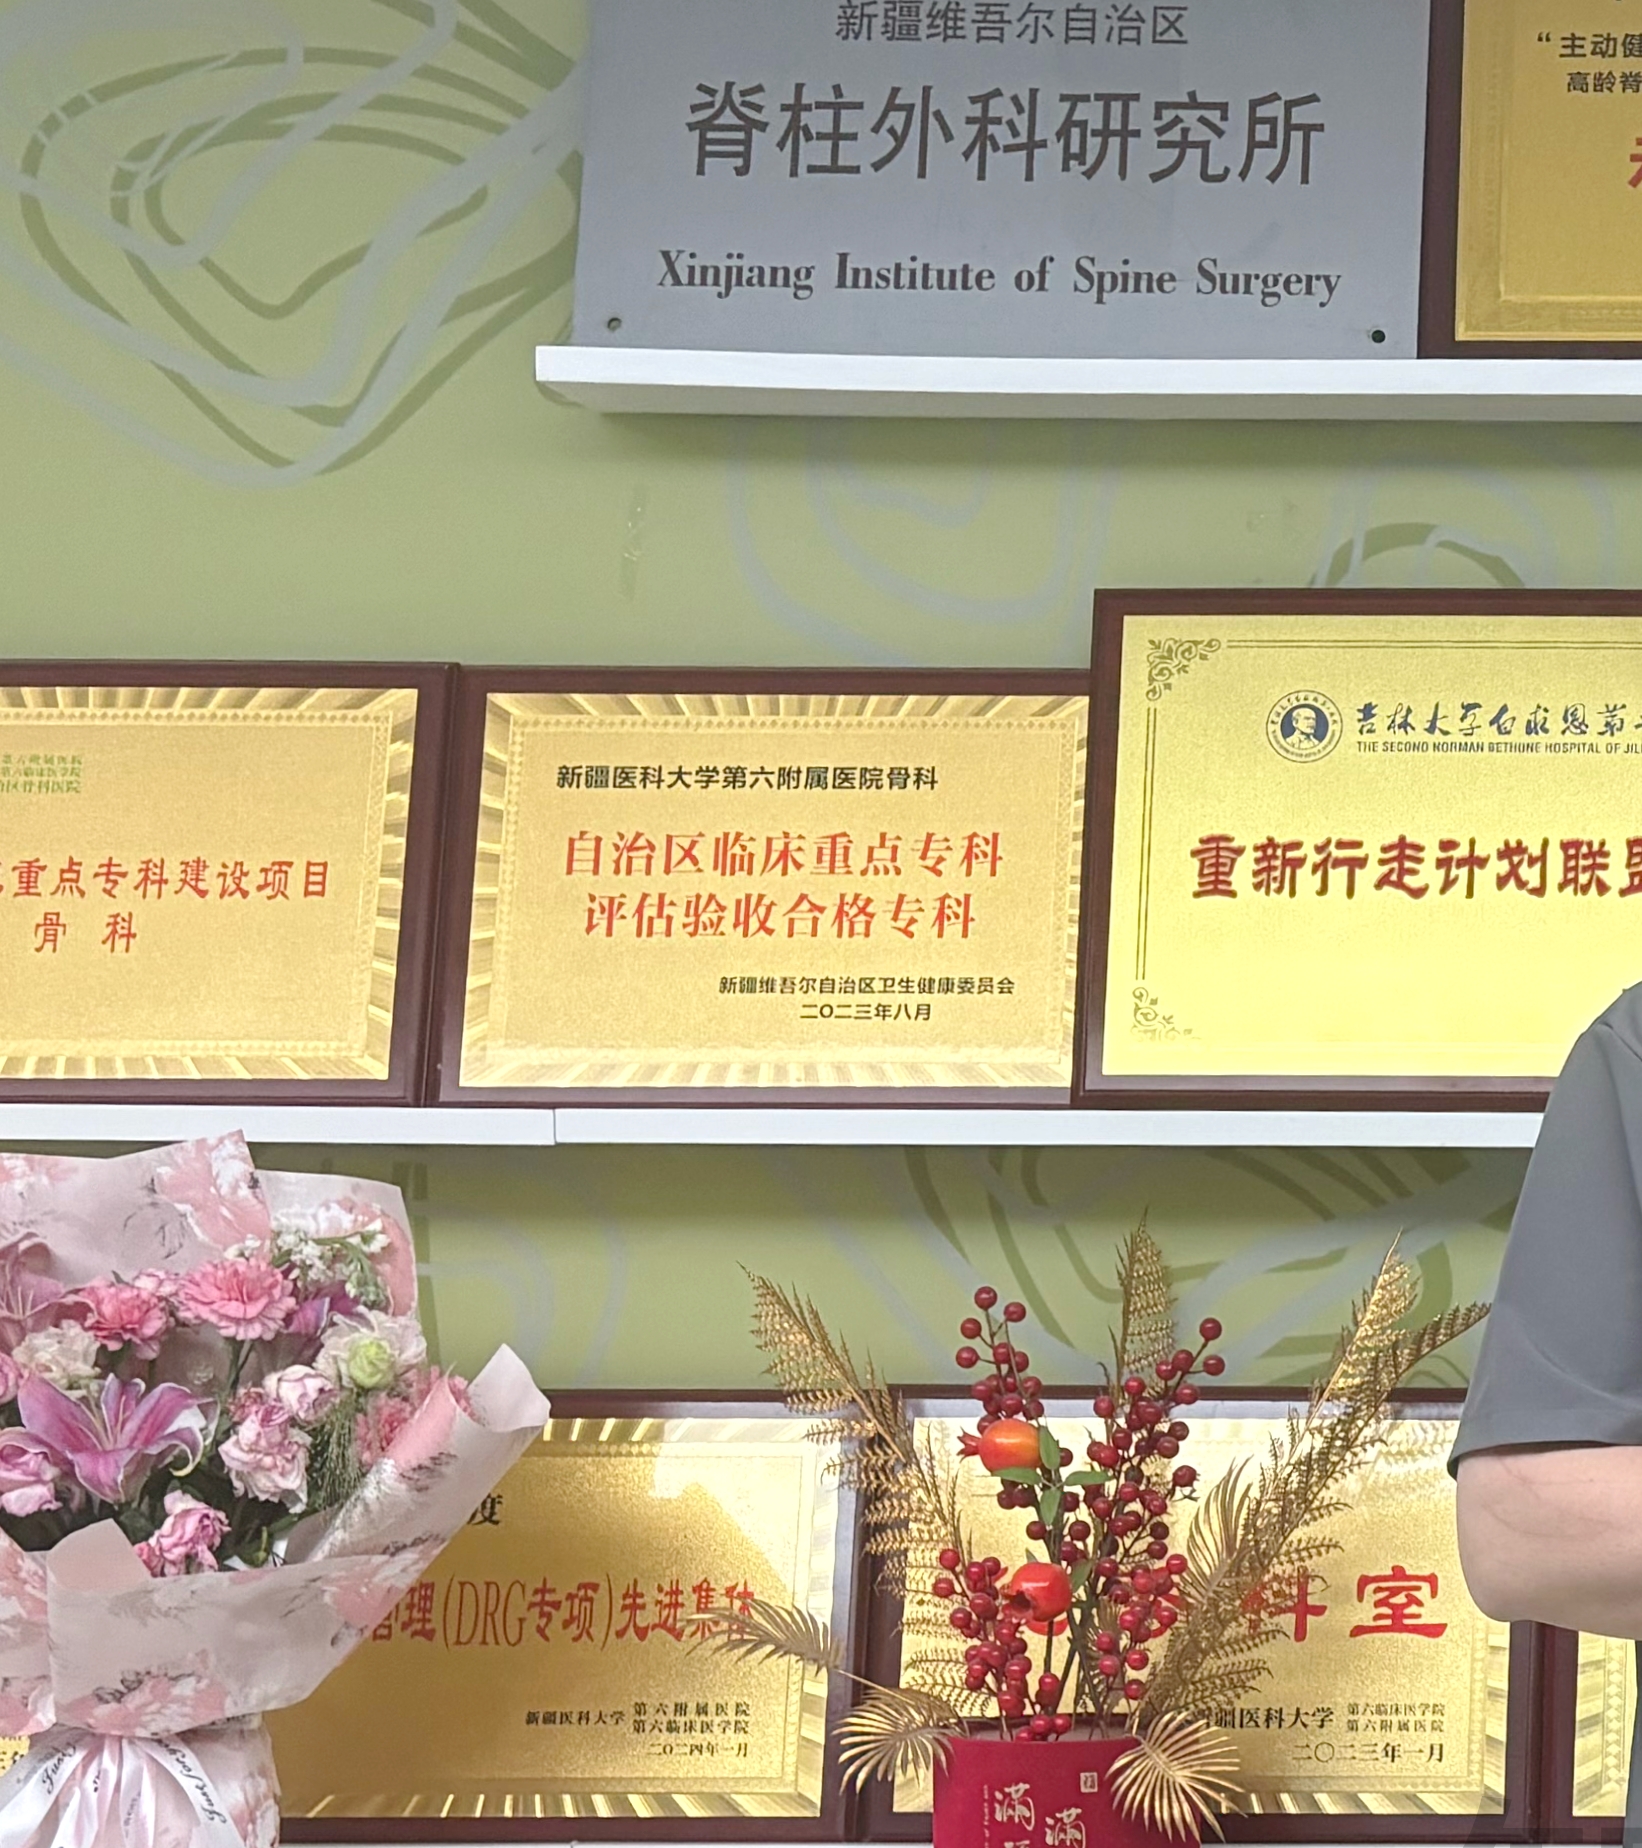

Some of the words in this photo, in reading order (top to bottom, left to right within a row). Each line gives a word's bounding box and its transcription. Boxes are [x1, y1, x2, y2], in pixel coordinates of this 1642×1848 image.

[835, 1, 1190, 46] 新疆维吾尔自治区
[686, 80, 1326, 186] 脊柱外科研究所
[656, 248, 816, 301] Xinjiang
[834, 251, 997, 294] Institute
[1013, 254, 1056, 296] of
[1072, 256, 1178, 304] Spine
[1195, 259, 1343, 308] Surgery
[1382, 740, 1429, 753] SECOND
[1433, 741, 1485, 753] NORMAN
[1488, 741, 1541, 754] BETHUNE
[1545, 742, 1601, 754] HOSPITAL
[557, 765, 939, 791] 新疆医科大学第六附属医院骨科
[565, 830, 1003, 878] 自治区临床重点专科
[0, 855, 329, 900] 重点专科建设项目
[584, 892, 977, 940] 评估验收合格专科
[719, 976, 1016, 997] 新疆维吾尔自治区卫生健康委员会
